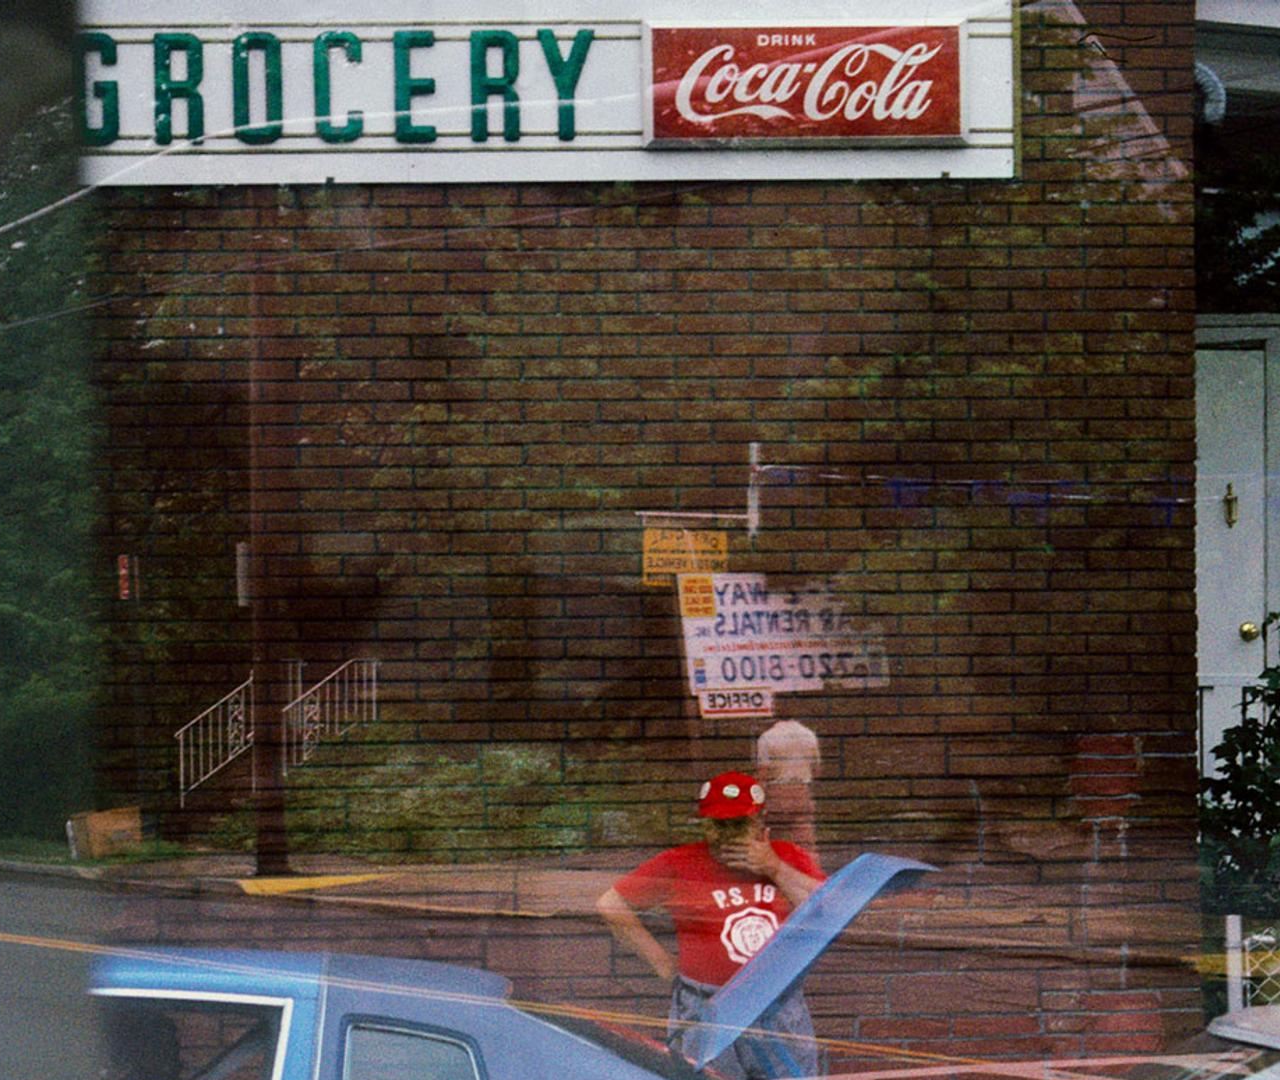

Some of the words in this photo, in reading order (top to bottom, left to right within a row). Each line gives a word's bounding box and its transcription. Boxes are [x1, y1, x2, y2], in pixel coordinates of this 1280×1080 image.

[756, 33, 818, 48] DRINK
[80, 28, 594, 147] GROCERY
[675, 42, 944, 123] Coca-Cola
[711, 885, 750, 910] P.S.
[753, 883, 777, 904] 19
